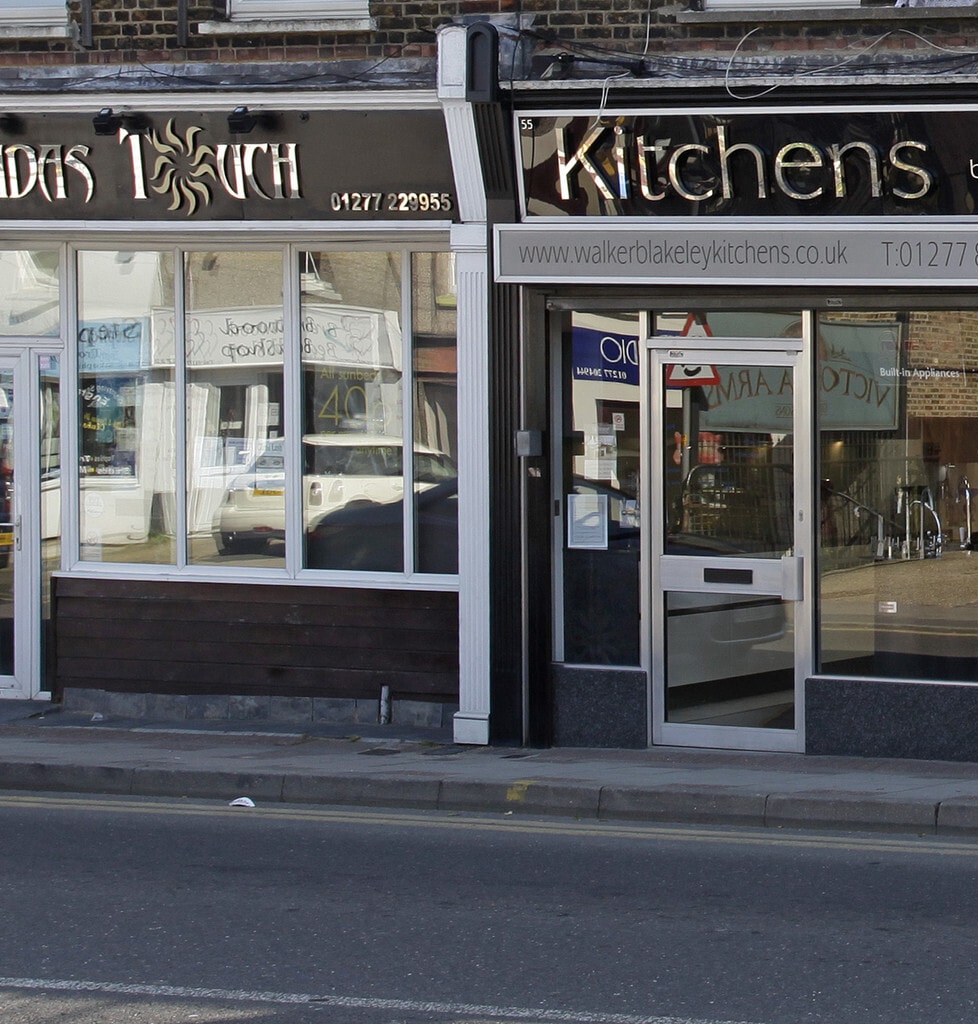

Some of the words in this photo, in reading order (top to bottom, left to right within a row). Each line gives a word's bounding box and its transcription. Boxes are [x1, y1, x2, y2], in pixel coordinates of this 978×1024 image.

[520, 119, 533, 130] 55
[555, 126, 931, 202] Kitchens
[331, 193, 380, 212] 01277
[388, 193, 452, 212] 229955
[519, 240, 848, 270] www.walkerblakeleykitchens.co.uk
[881, 242, 968, 268] T:01277
[320, 367, 335, 379] All
[879, 367, 911, 377] Built-in
[912, 367, 960, 380] Appliances
